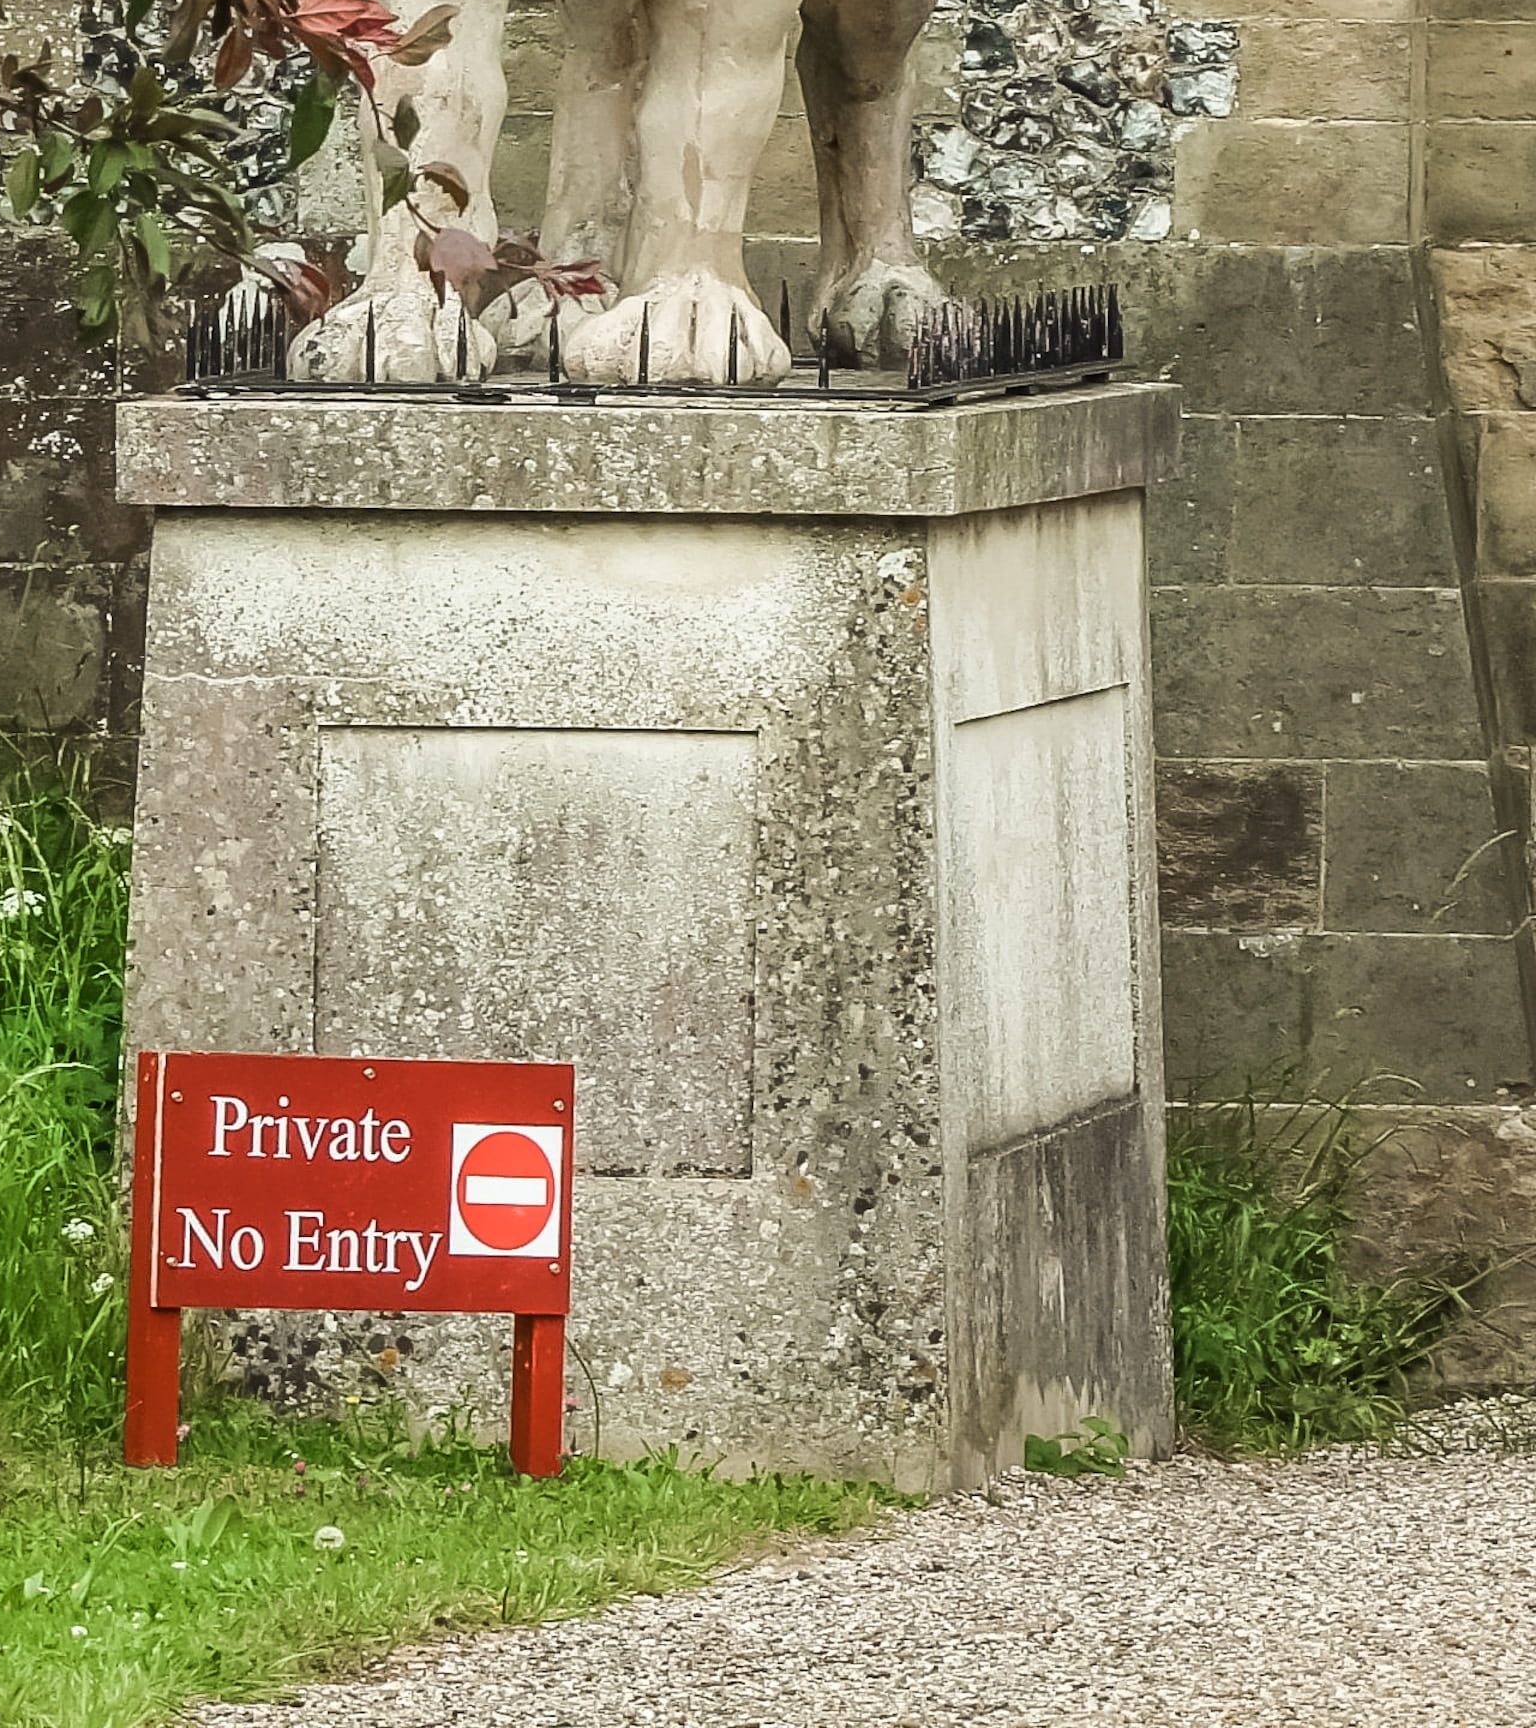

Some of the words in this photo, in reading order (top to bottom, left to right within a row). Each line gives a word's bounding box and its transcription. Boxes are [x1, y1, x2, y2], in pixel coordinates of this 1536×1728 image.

[207, 1095, 412, 1163] Private
[175, 1207, 265, 1271] No
[282, 1210, 443, 1292] Entry
